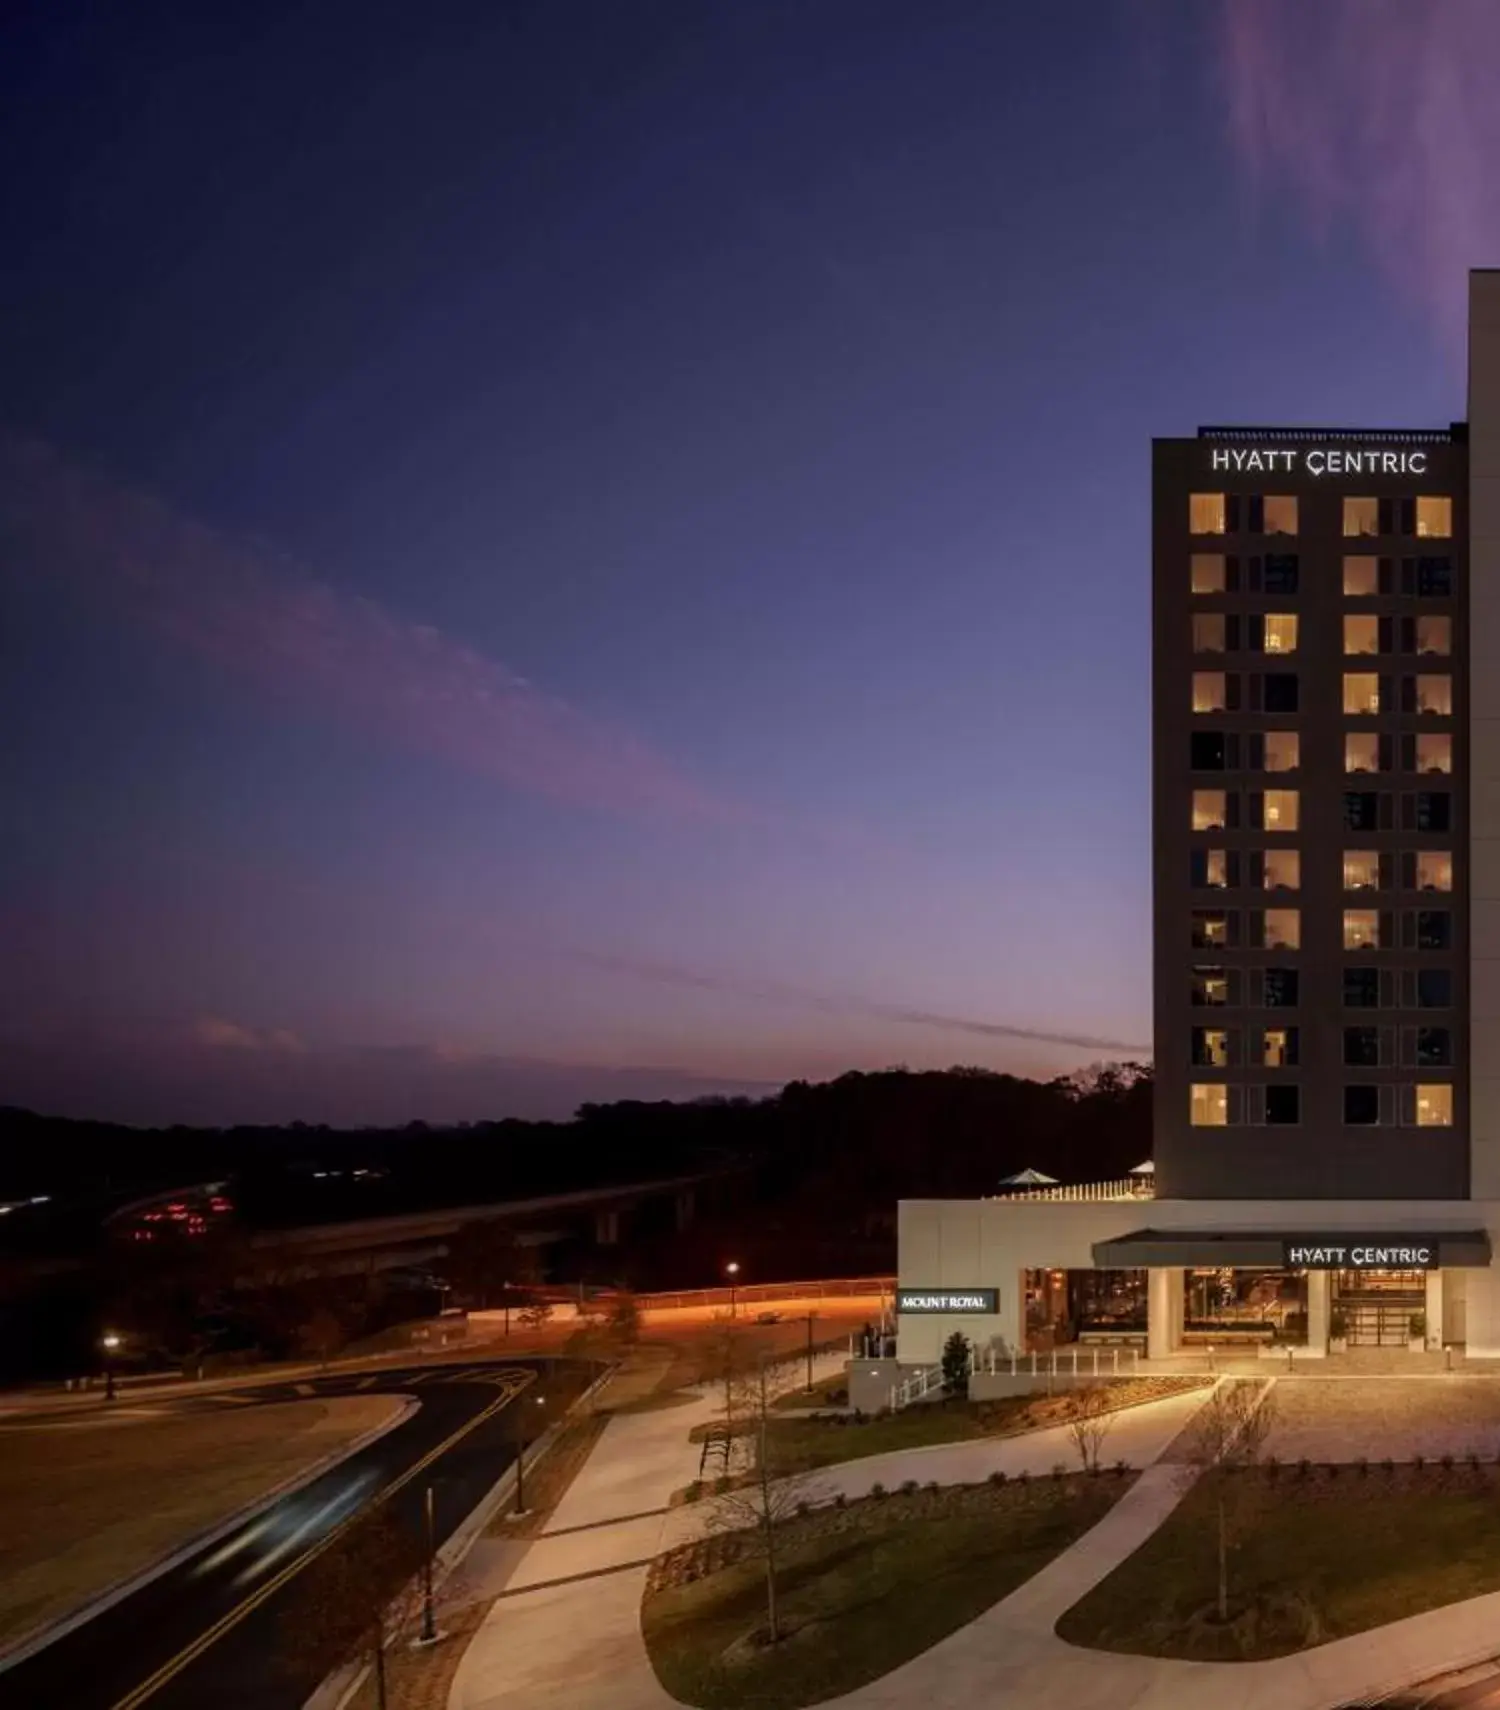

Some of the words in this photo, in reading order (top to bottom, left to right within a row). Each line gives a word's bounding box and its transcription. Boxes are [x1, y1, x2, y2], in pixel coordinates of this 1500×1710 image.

[1211, 450, 1297, 471] HYATT
[1305, 450, 1427, 474] CENTRIC
[1290, 1247, 1346, 1263] HYATT
[1351, 1247, 1430, 1264] CENTRIC
[902, 1296, 946, 1309] MOUNT
[949, 1296, 986, 1309] ROYAL
